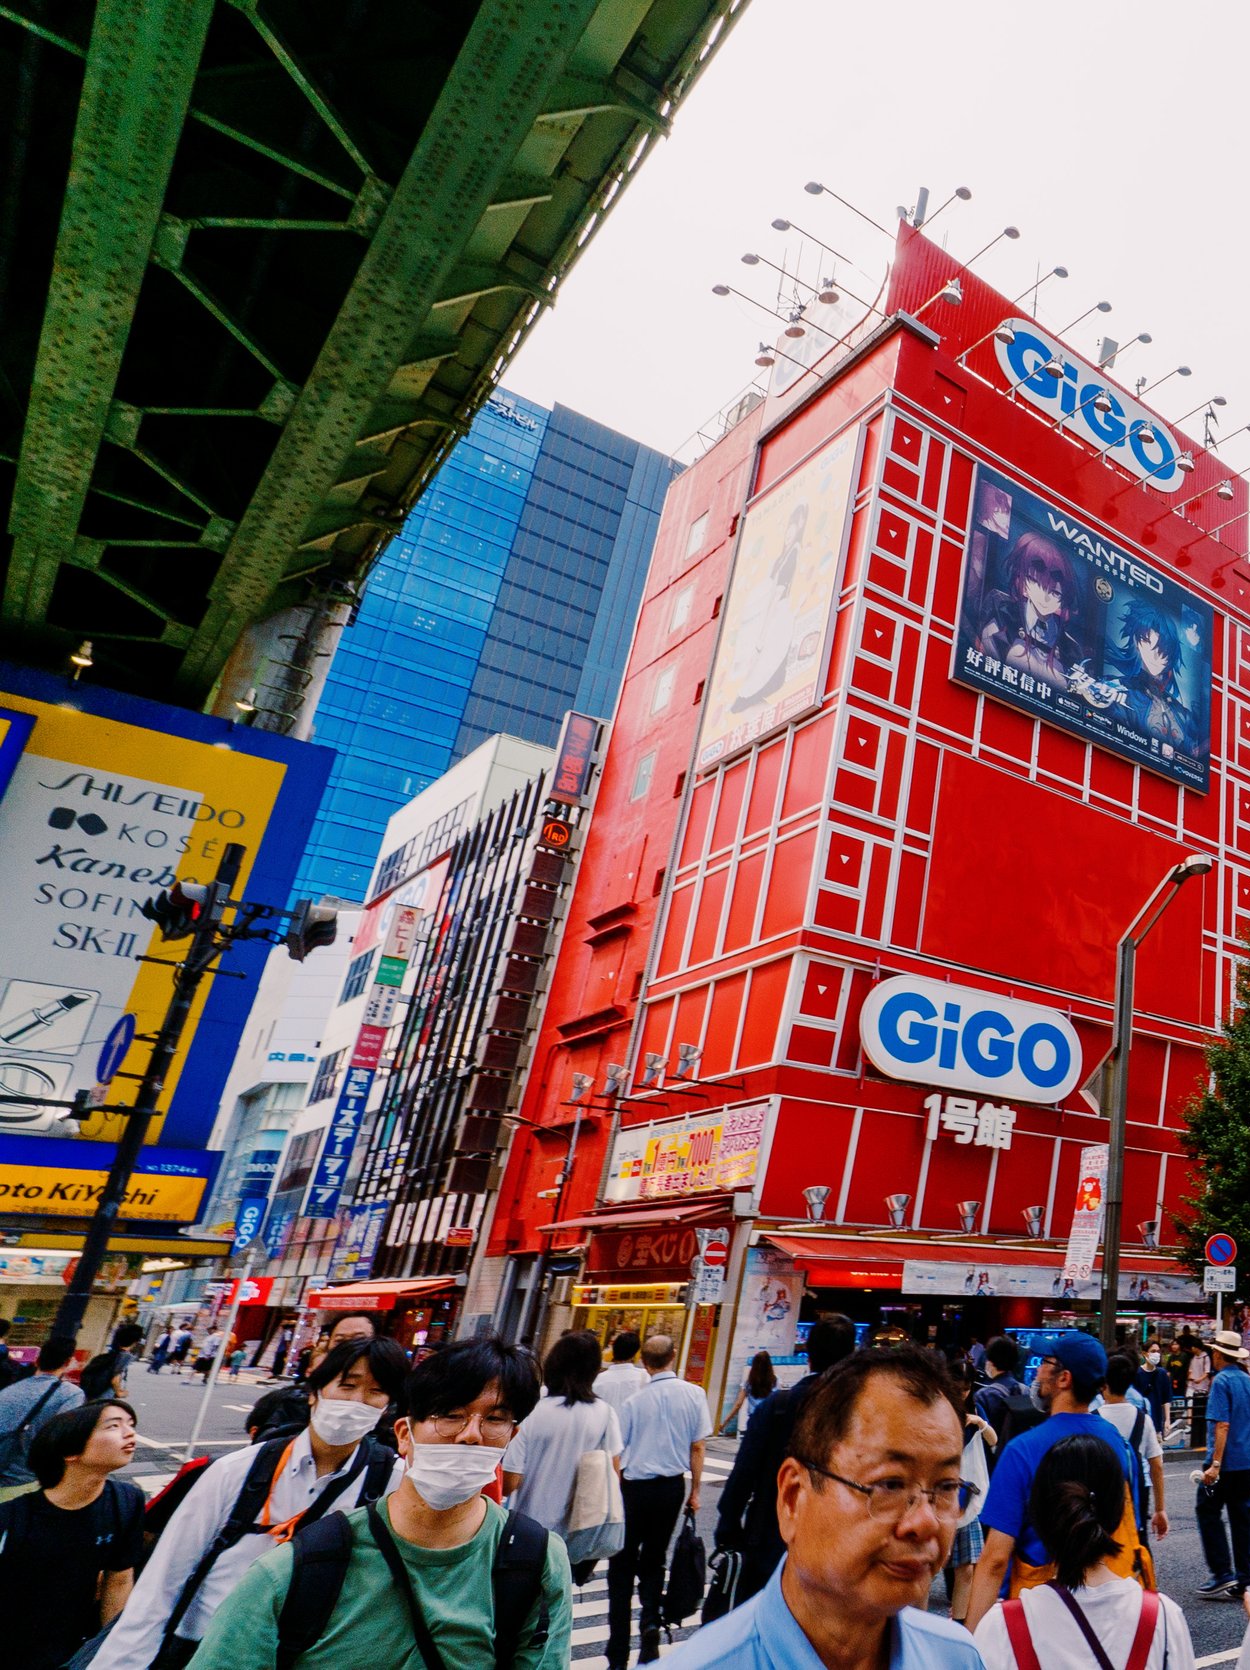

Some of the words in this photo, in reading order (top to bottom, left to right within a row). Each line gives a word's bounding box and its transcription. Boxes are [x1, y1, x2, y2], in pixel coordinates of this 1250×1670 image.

[1006, 331, 1177, 481] GiGO
[1047, 511, 1164, 595] WANTED
[966, 646, 1052, 700] 好評配信中
[1116, 723, 1149, 747] Windows
[37, 772, 246, 829] SHISEIDO
[117, 823, 220, 860] KOSÉ
[34, 883, 147, 919] SOFIN
[52, 922, 139, 959] SK-II
[877, 991, 1071, 1089] GiGO
[313, 1067, 371, 1204] ホビーステーション
[924, 1093, 1017, 1151] 1号館
[235, 1206, 260, 1249] GiGO
